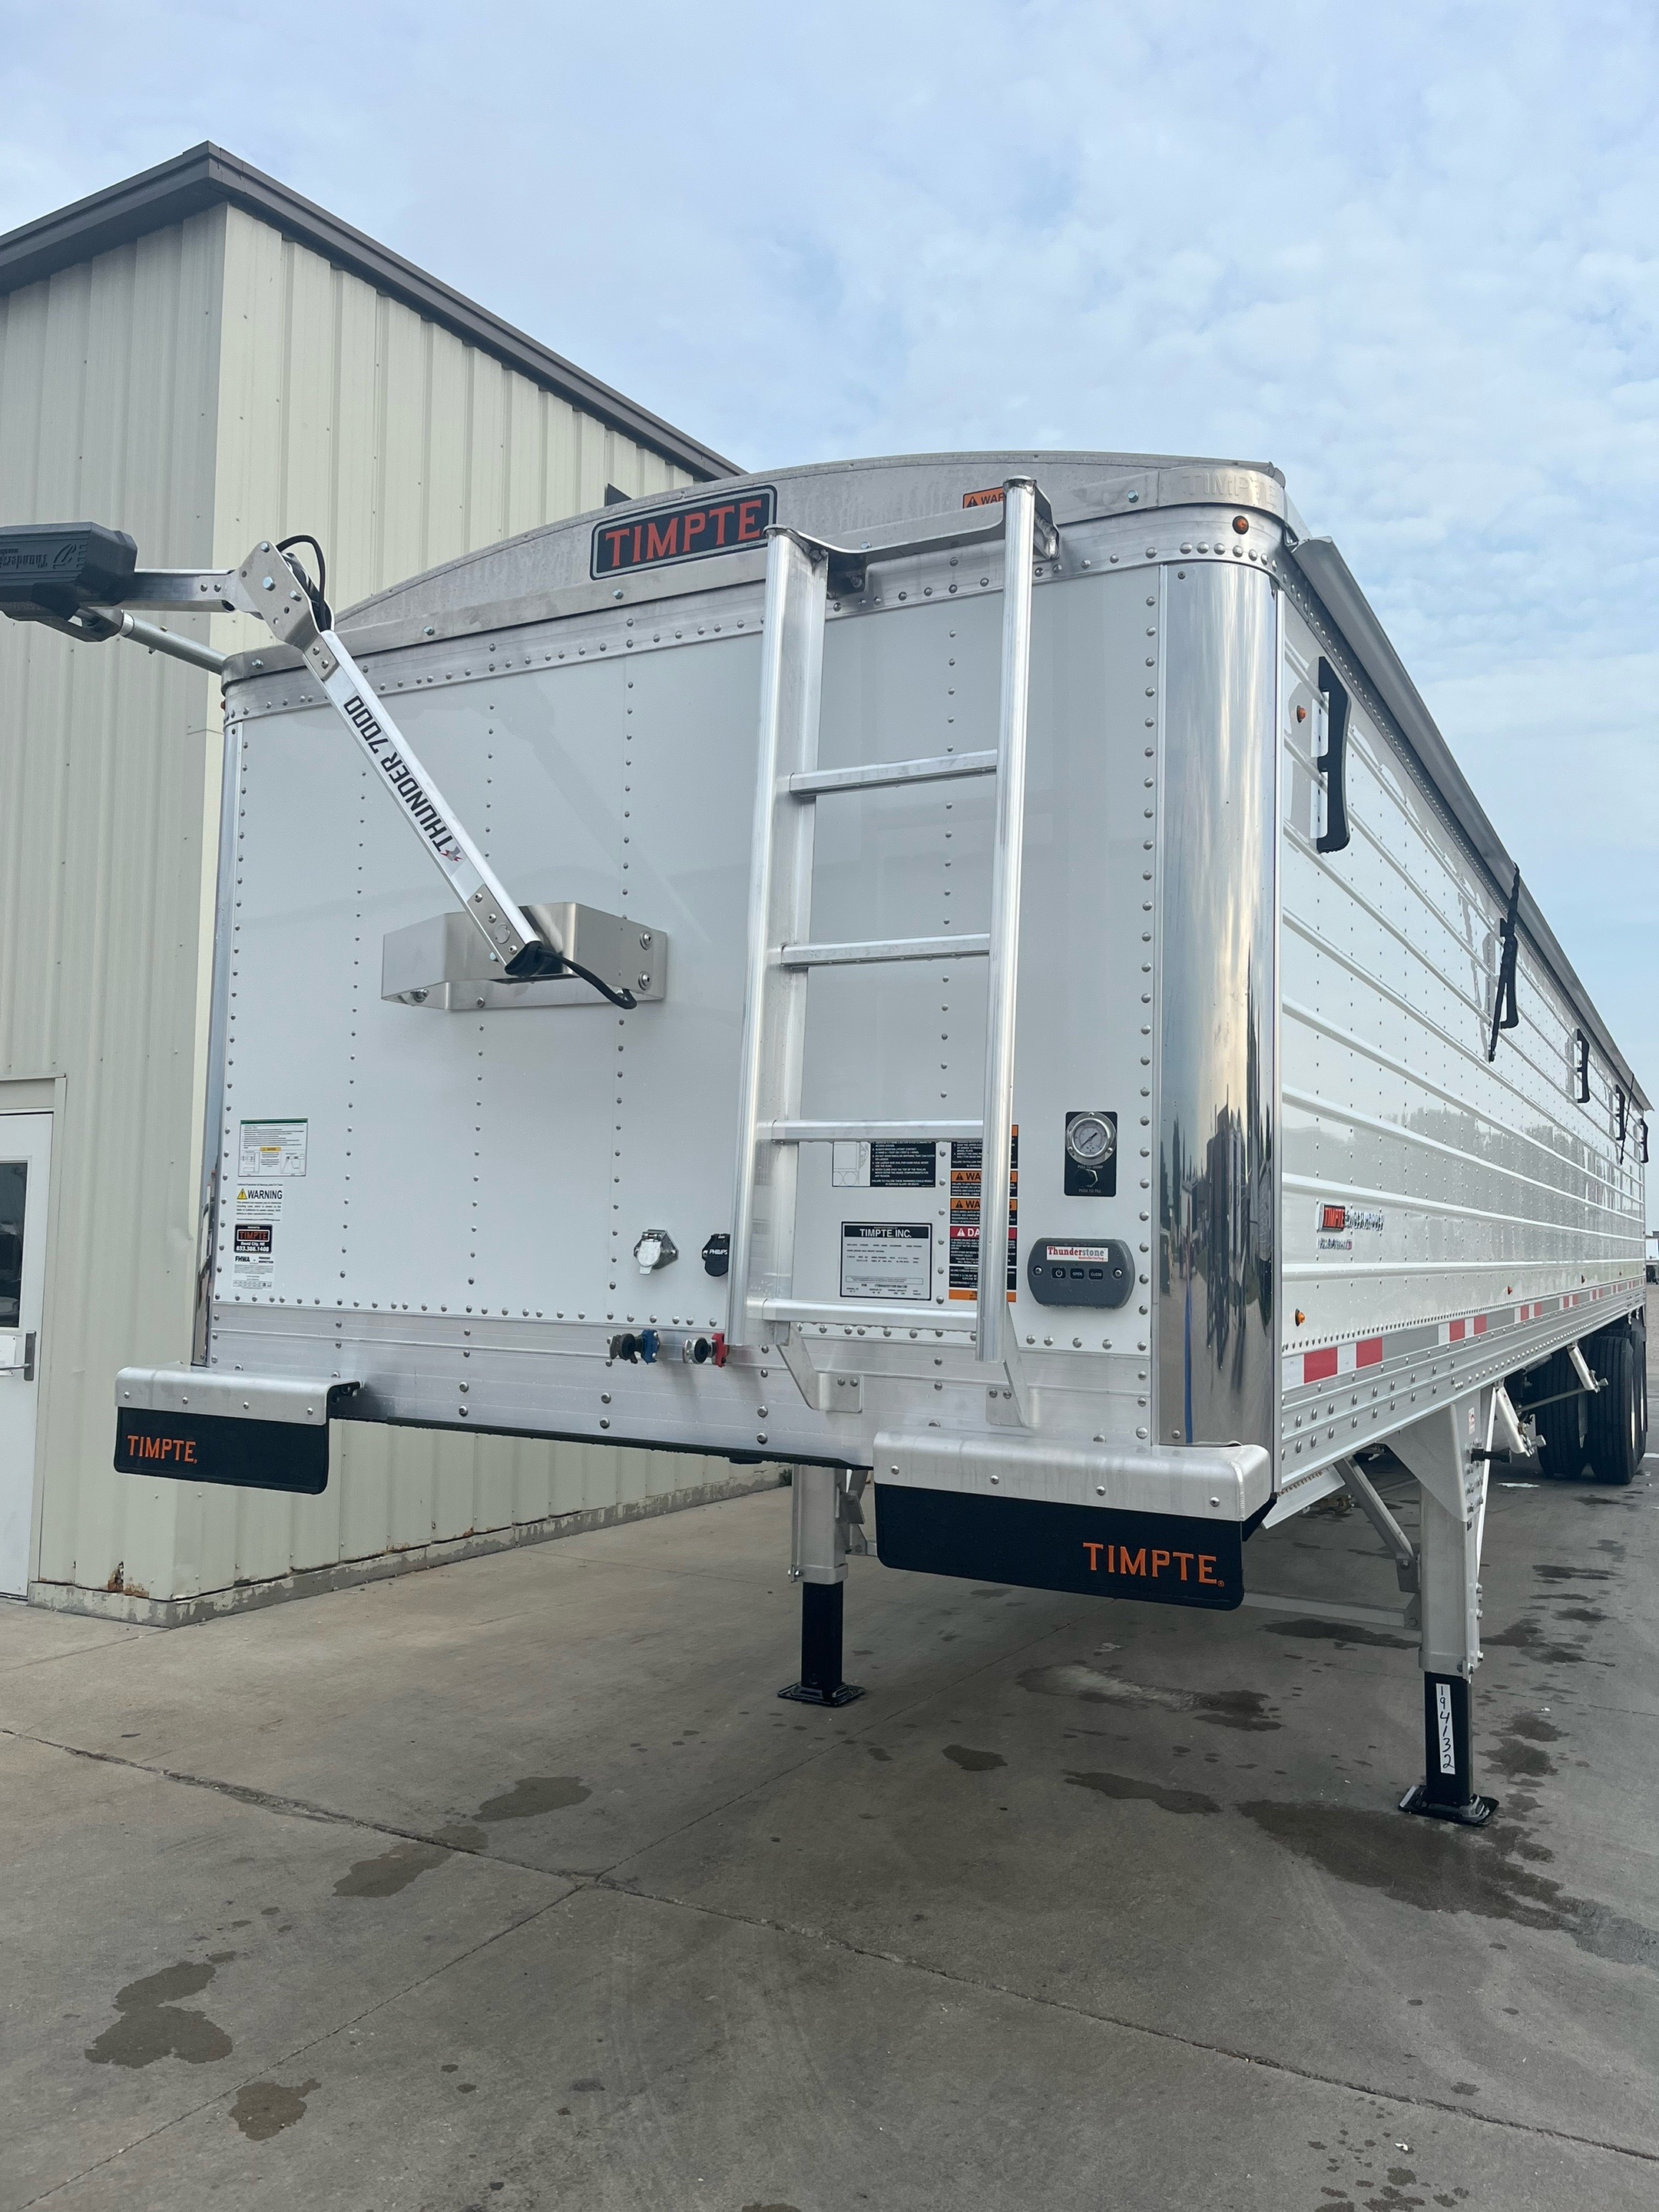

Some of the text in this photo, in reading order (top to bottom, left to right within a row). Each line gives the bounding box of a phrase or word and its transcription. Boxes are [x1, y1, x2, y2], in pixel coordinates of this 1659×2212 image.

[604, 499, 762, 567] TIMPTE
[343, 695, 453, 853] THUNDER 7000
[247, 1190, 283, 1199] WARNING
[239, 1231, 268, 1240] TIMPTE
[859, 1229, 912, 1238] TIMPTE INC.
[1048, 1247, 1104, 1257] Thunderstone
[127, 1435, 197, 1464] TIMPTE
[1082, 1541, 1225, 1588] TIMPTE
